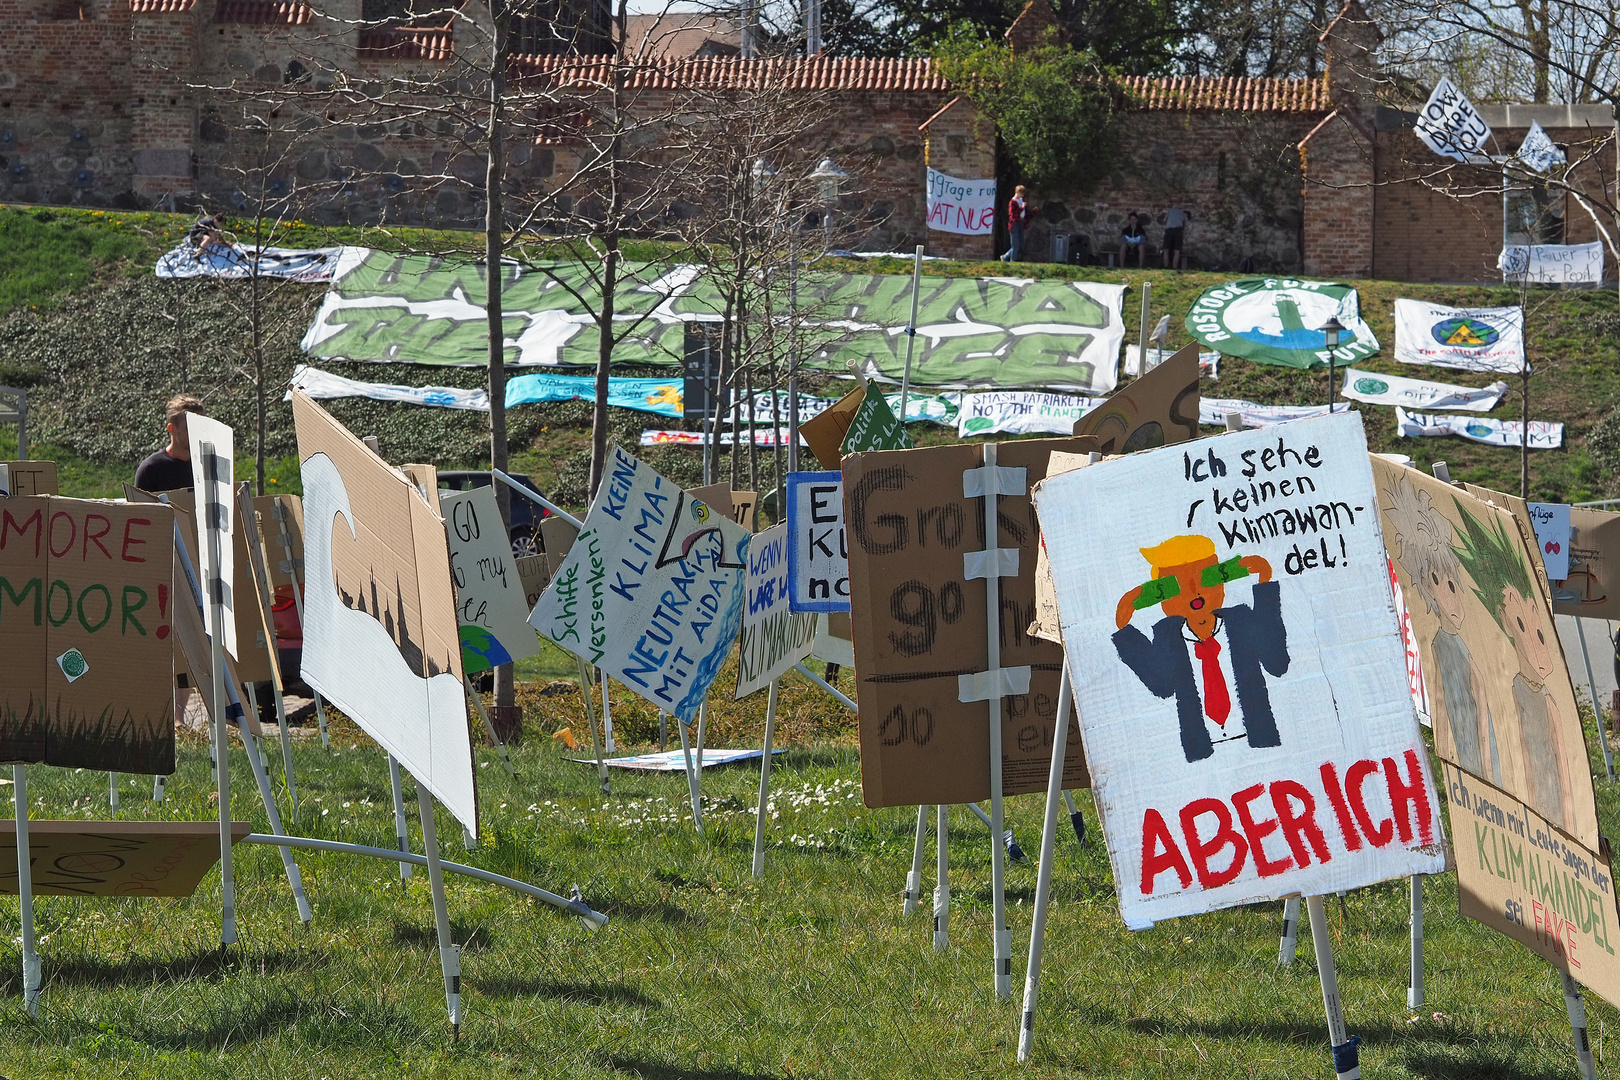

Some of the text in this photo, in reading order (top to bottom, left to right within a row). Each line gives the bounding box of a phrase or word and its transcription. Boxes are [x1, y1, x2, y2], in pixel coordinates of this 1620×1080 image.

[1430, 99, 1473, 149] DARE
[1192, 282, 1249, 343] ROSTOCK
[973, 393, 1093, 407] SMASH PATRIARCHY
[973, 403, 1087, 419] NOT THE PLANET
[602, 449, 638, 521] KEiNE
[1184, 437, 1323, 482] Ich sehe
[453, 500, 480, 542] GO
[1212, 476, 1316, 515] keinen
[0, 508, 151, 562] MORE
[609, 477, 669, 601] KLiMA-
[750, 536, 783, 577] WENN
[476, 556, 508, 589] my
[0, 576, 170, 640] MOOR!
[551, 563, 581, 643] Schiffe
[654, 646, 694, 702] MiT
[1507, 810, 1524, 838] mir
[1523, 804, 1561, 858] Leute
[1562, 843, 1590, 880] sagen
[1591, 851, 1609, 894] der
[1474, 821, 1615, 956] KLIMAWANDEL
[1505, 898, 1581, 969] sei FAKE
